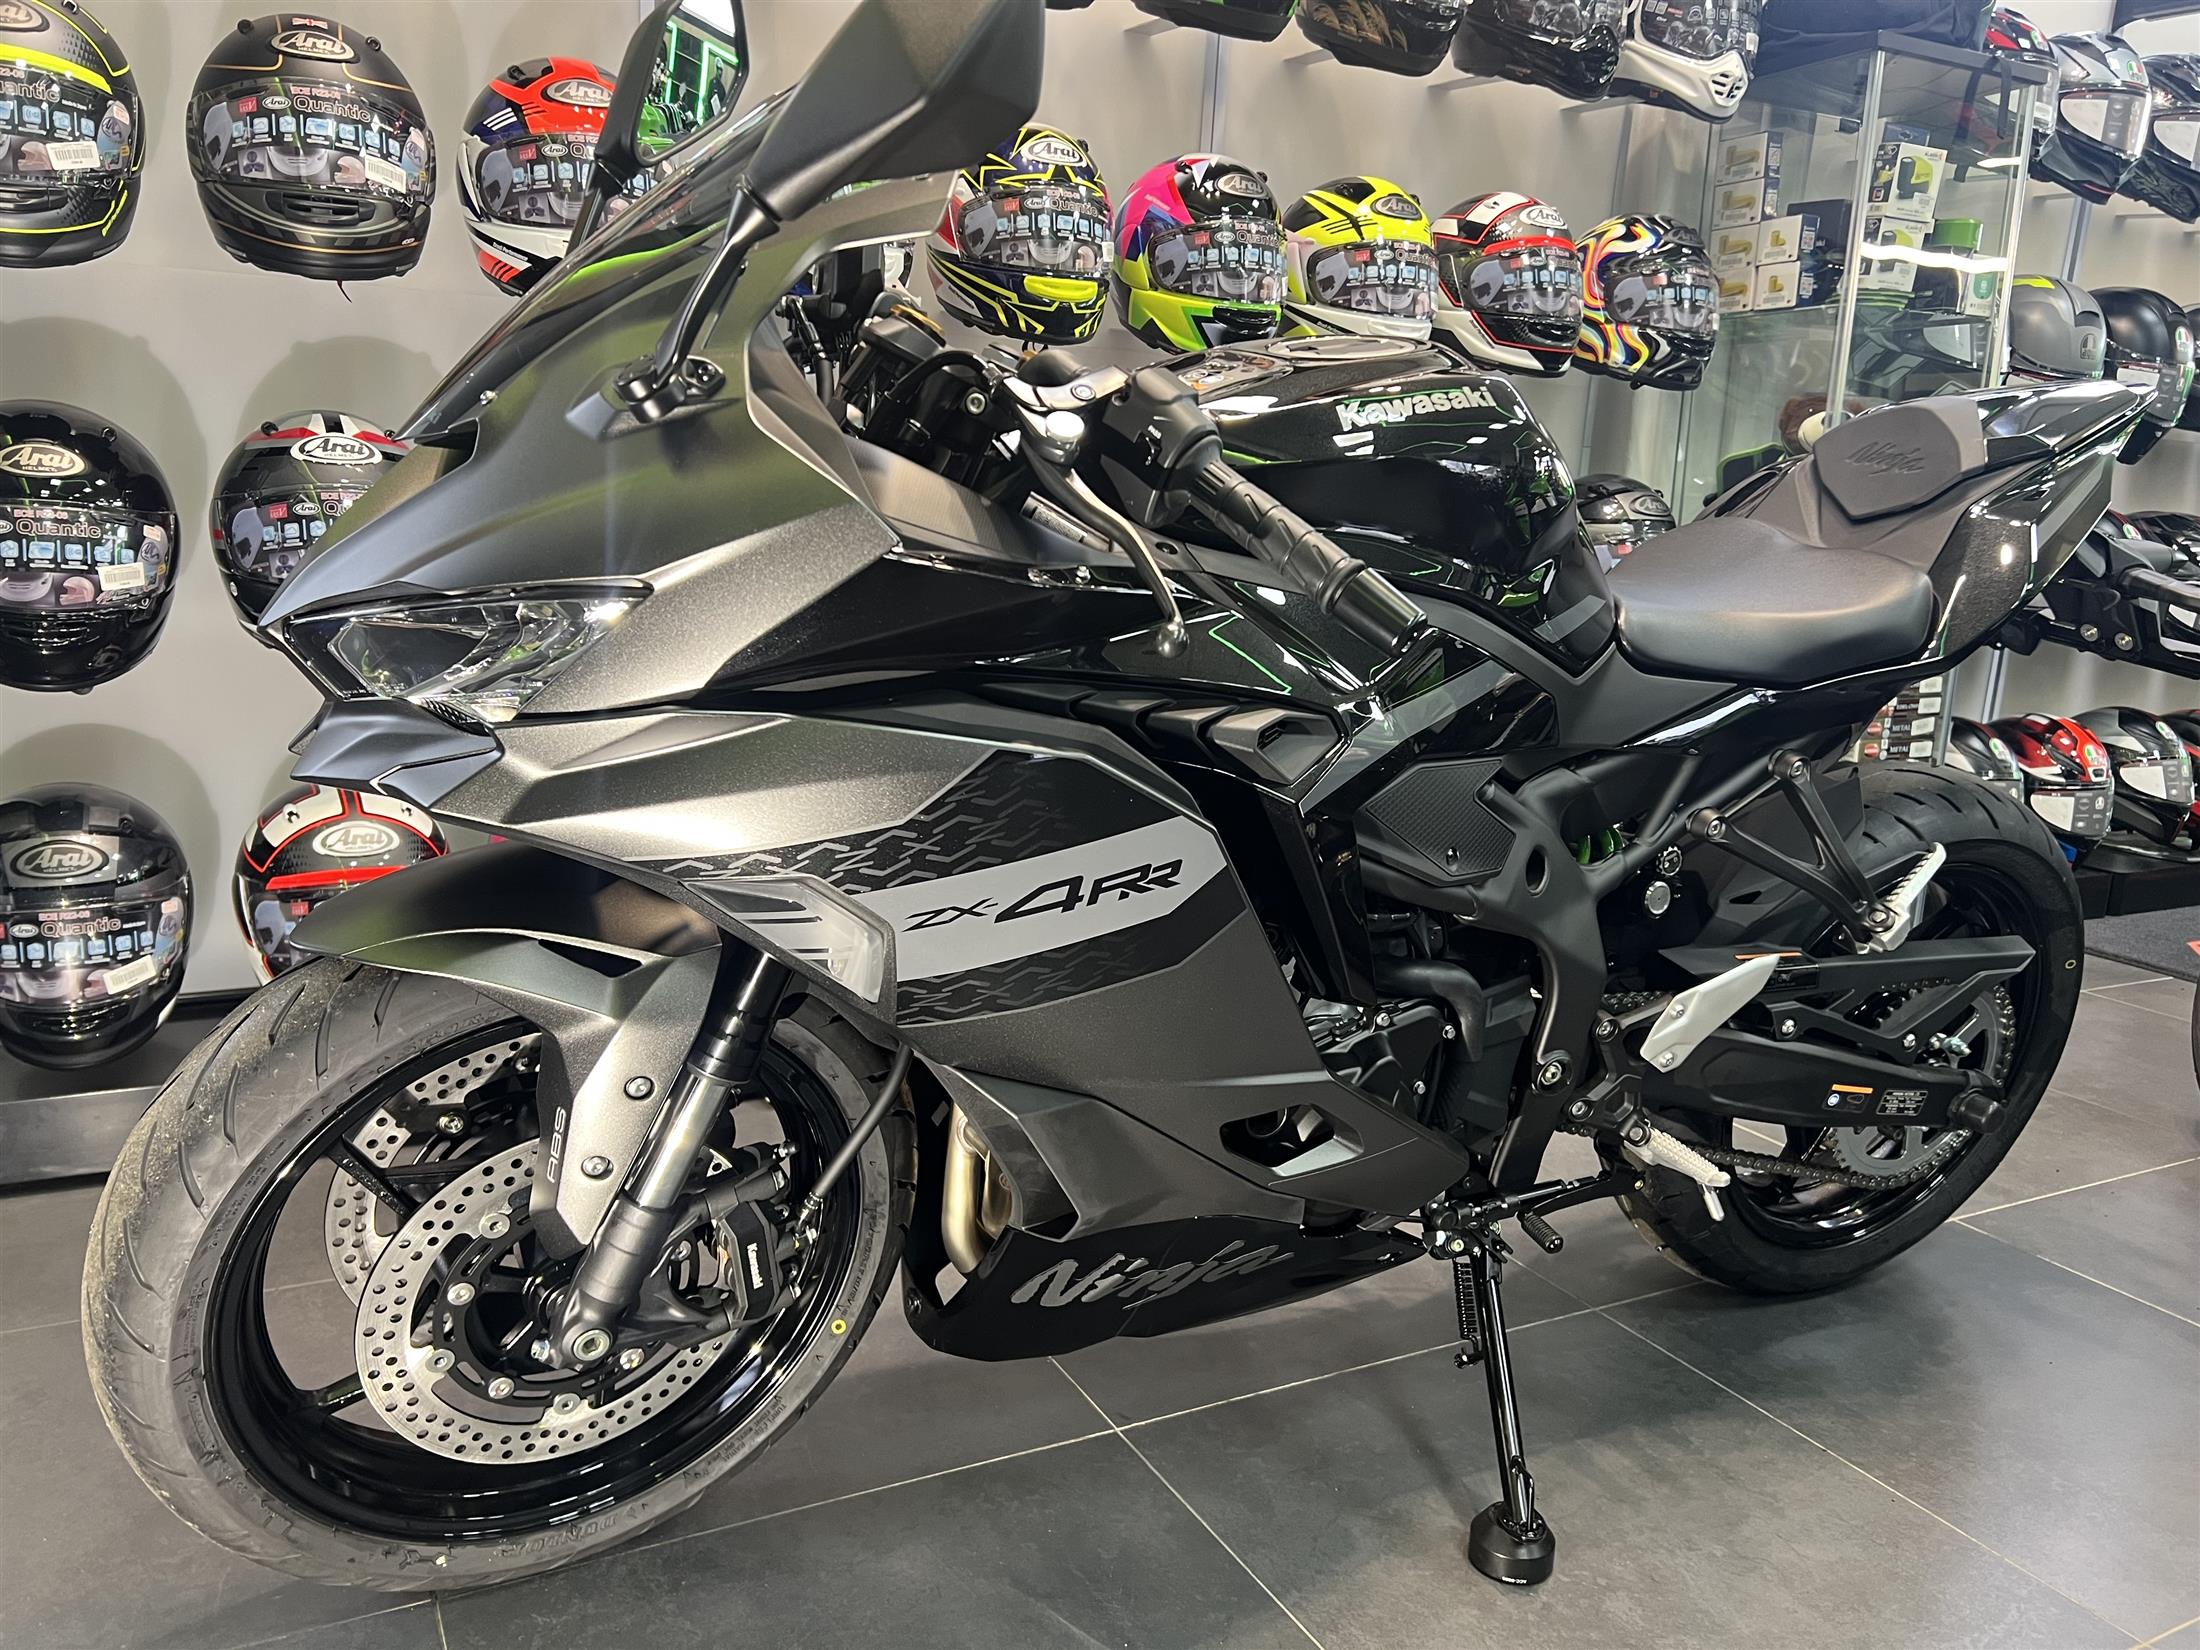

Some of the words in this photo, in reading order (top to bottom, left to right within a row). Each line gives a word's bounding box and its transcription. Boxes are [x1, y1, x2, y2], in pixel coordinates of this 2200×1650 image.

[279, 32, 345, 53] Arai
[0, 81, 60, 101] antic
[293, 95, 371, 123] Quantic
[1037, 141, 1079, 158] Arai
[1227, 176, 1263, 193] Arai
[1336, 386, 1497, 431] Kawasaki
[1, 446, 74, 468] Arai
[304, 438, 367, 455] Arai
[1844, 441, 1926, 477] Ninja
[16, 519, 101, 538] Quantic
[326, 828, 385, 848] Arai
[26, 849, 94, 871] Arai
[902, 858, 1183, 932] ZX-4RR
[41, 916, 121, 937] Quantic
[546, 1106, 567, 1183] ABS
[1010, 1239, 1295, 1310] Ninja
